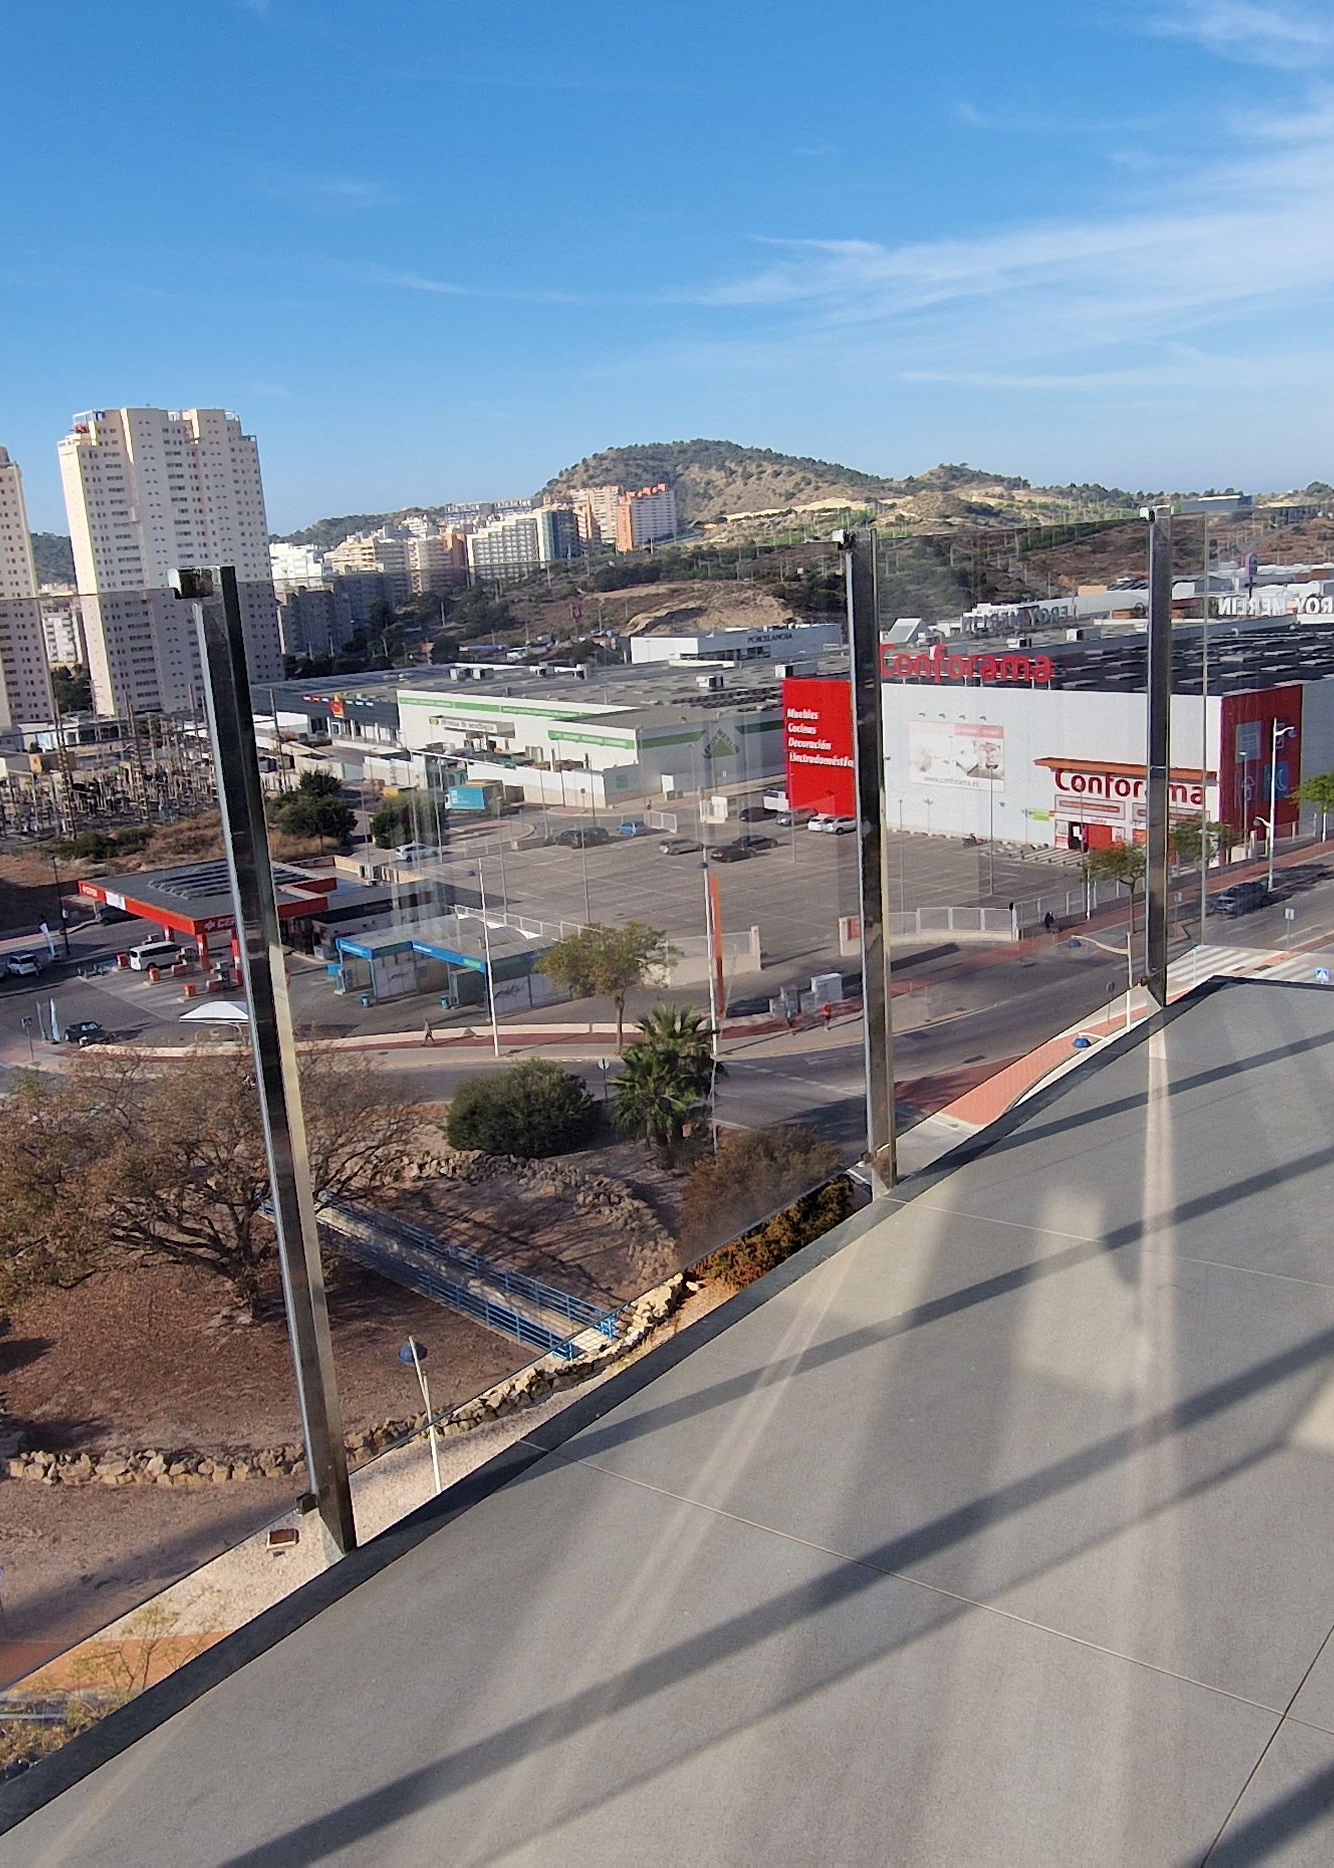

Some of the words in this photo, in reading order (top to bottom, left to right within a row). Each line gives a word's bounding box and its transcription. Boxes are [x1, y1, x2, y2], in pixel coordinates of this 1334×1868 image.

[879, 643, 1053, 683] Conforama
[787, 708, 819, 719] Muebles
[788, 723, 817, 734] Cocinas
[788, 737, 831, 750] Decoración
[1054, 769, 1204, 805] Conforma
